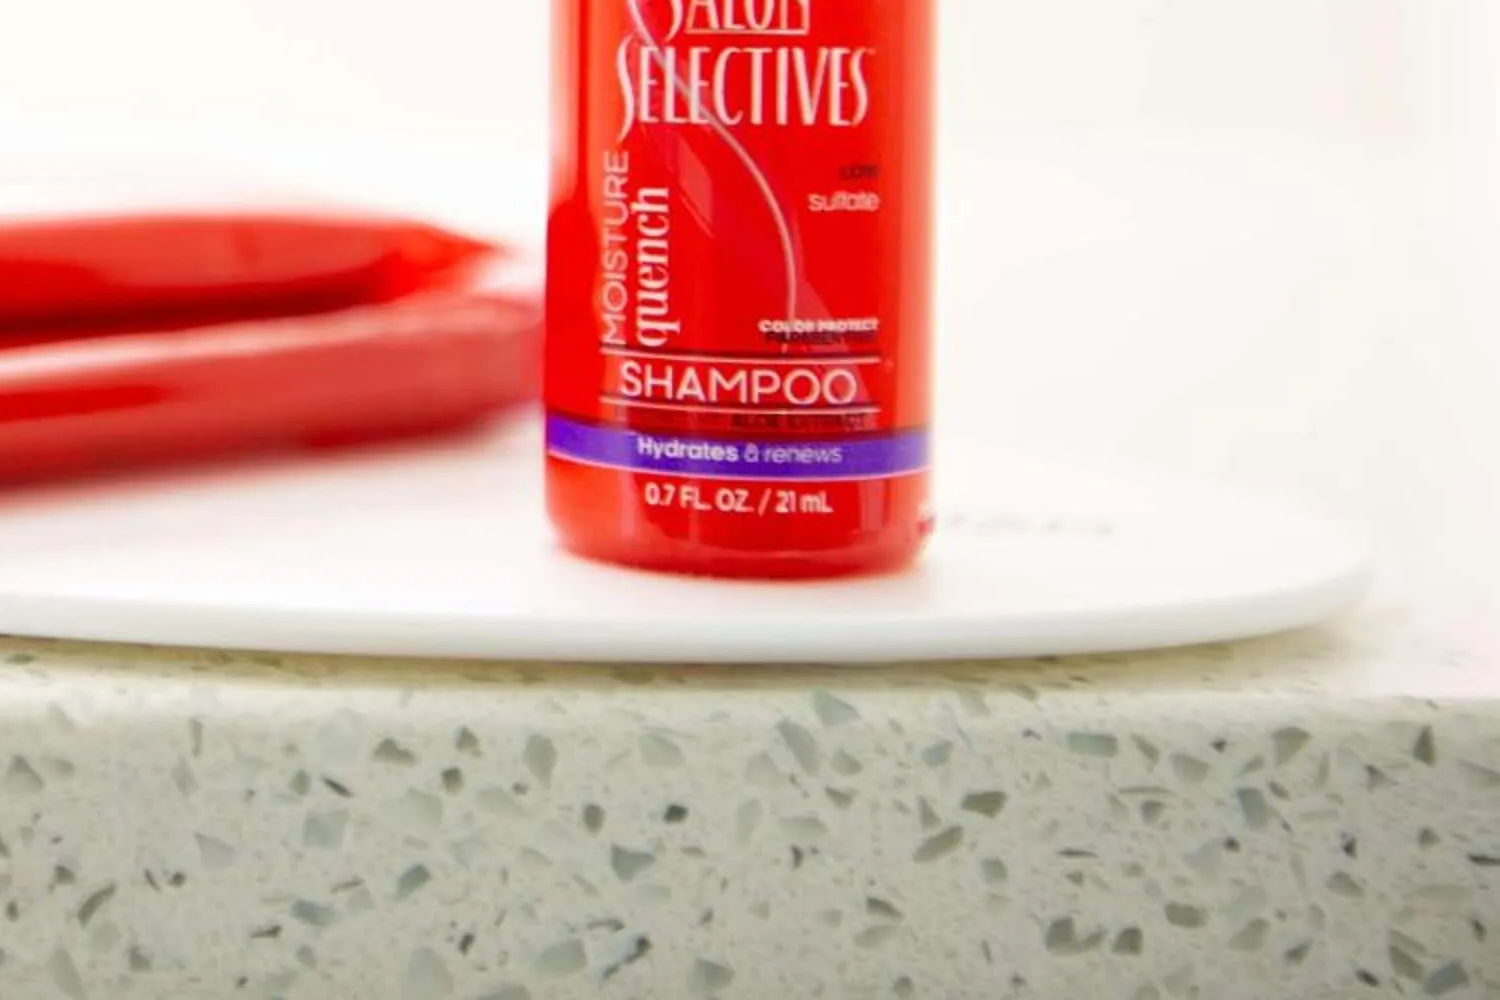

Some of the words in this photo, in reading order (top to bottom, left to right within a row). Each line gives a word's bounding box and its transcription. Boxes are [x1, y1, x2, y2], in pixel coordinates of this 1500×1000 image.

[615, 33, 869, 143] SELECTIVES
[602, 150, 630, 346] MOISTURE
[630, 186, 681, 348] quench
[757, 318, 814, 334] COLOR
[619, 360, 858, 405] SHAMPOO
[636, 436, 739, 461] Hydrates
[763, 445, 844, 464] renews
[644, 481, 676, 506] 0.7
[757, 487, 773, 517] /
[775, 489, 797, 513] 21
[800, 489, 834, 514] mL
